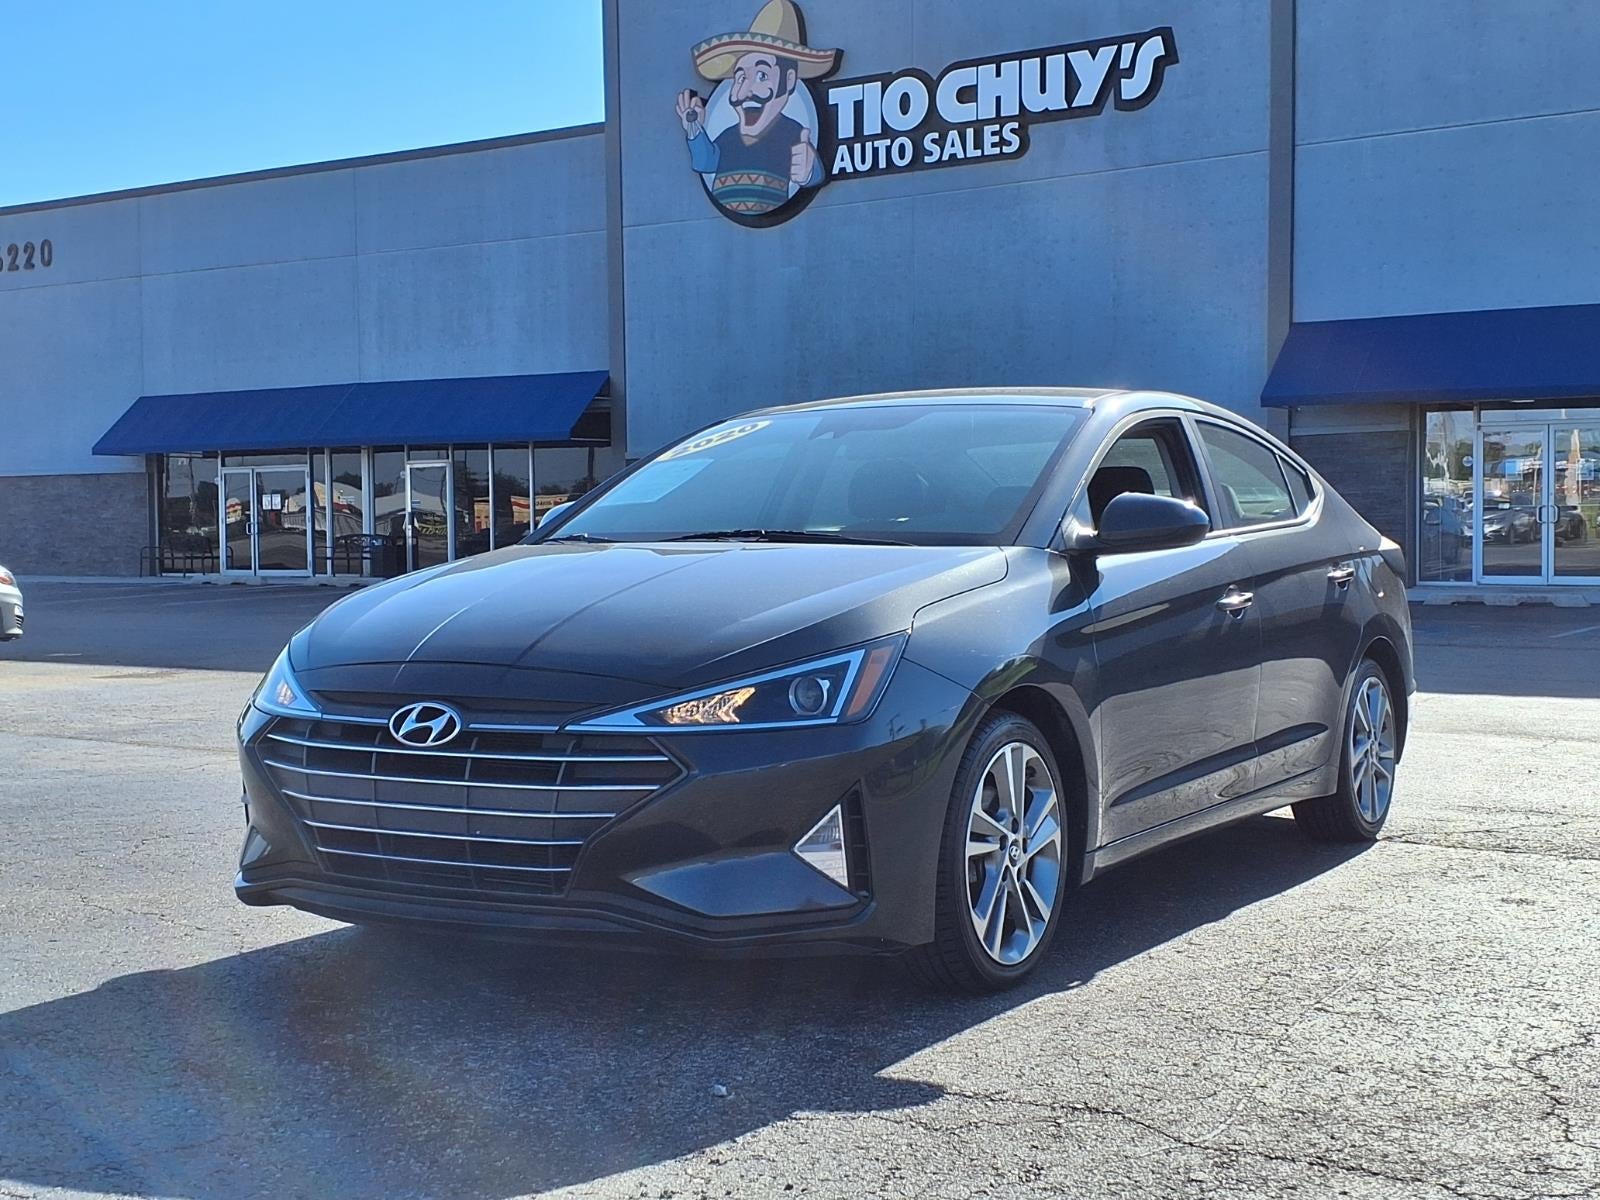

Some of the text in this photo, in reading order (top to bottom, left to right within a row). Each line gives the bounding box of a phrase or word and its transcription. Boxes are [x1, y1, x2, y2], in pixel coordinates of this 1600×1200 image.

[828, 35, 1166, 139] TIO CHUY'S
[832, 122, 1020, 174] AUTO SALES
[668, 423, 760, 459] 2020
